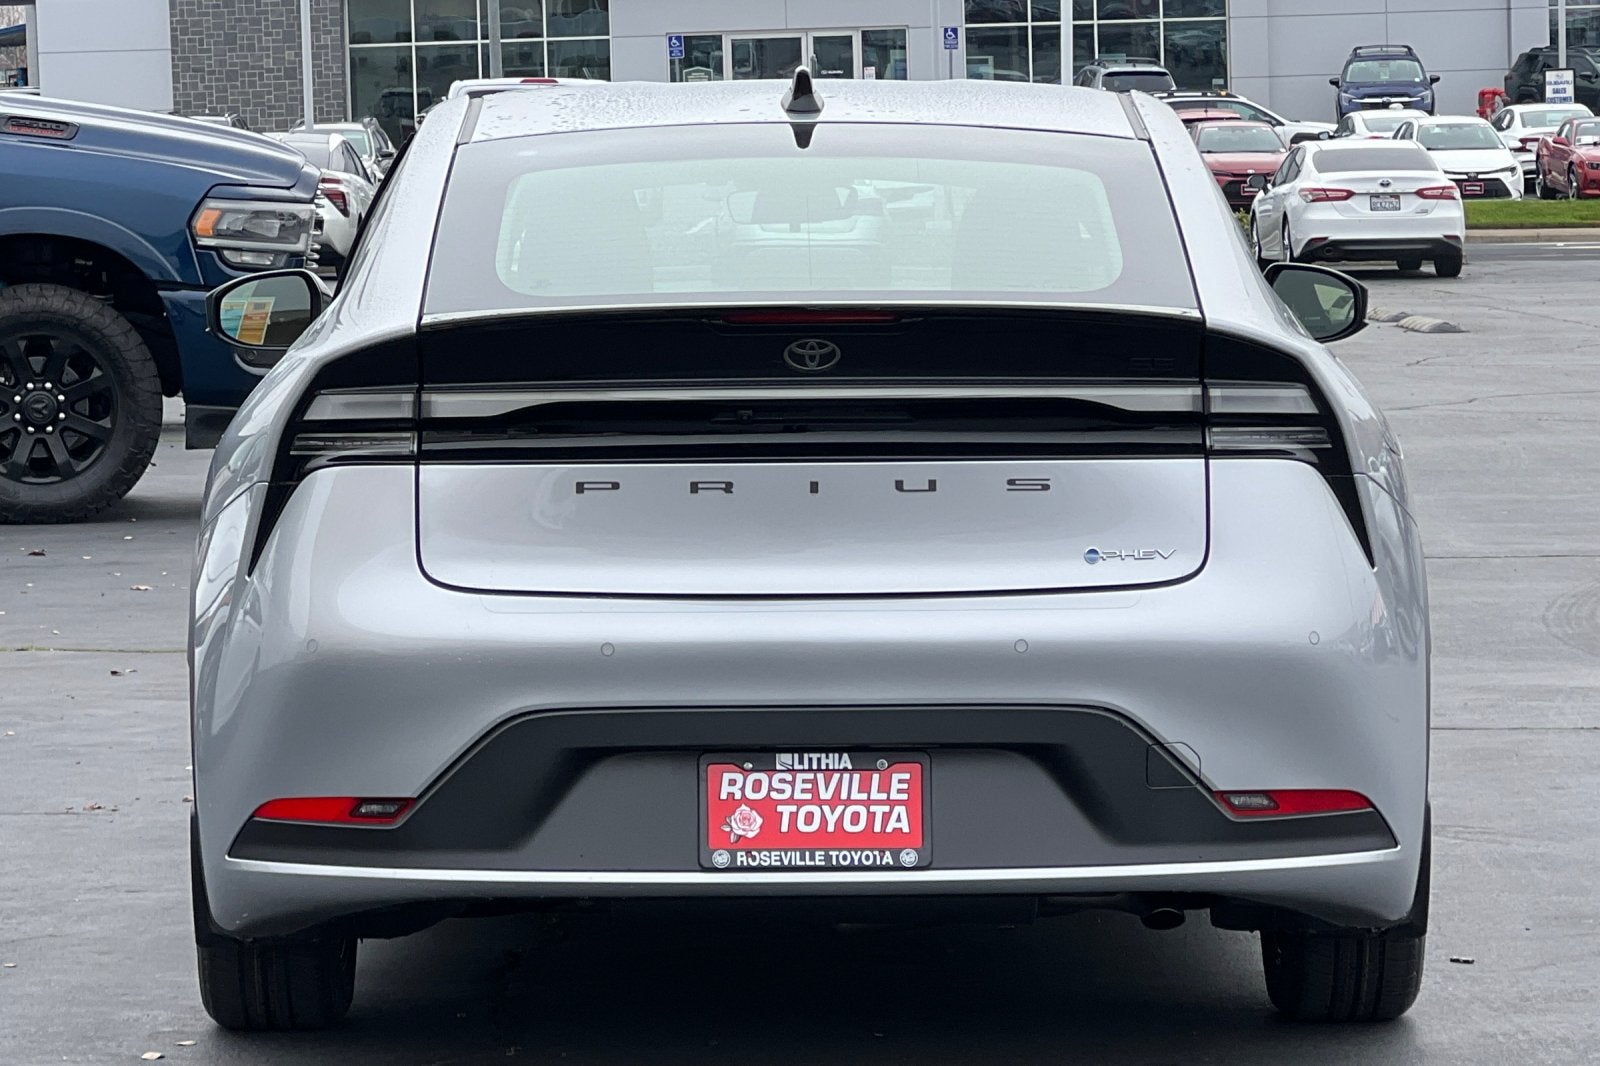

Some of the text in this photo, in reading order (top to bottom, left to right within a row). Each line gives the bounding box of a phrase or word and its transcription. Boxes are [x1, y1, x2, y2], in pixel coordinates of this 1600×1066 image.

[575, 478, 1051, 495] PRIUS
[1101, 548, 1177, 561] PHEV
[793, 753, 852, 770] LITHIA
[719, 772, 911, 801] ROSEVILLE
[776, 805, 911, 833] TOYOTA
[737, 850, 894, 866] ROSEVILLE TOYOTA
